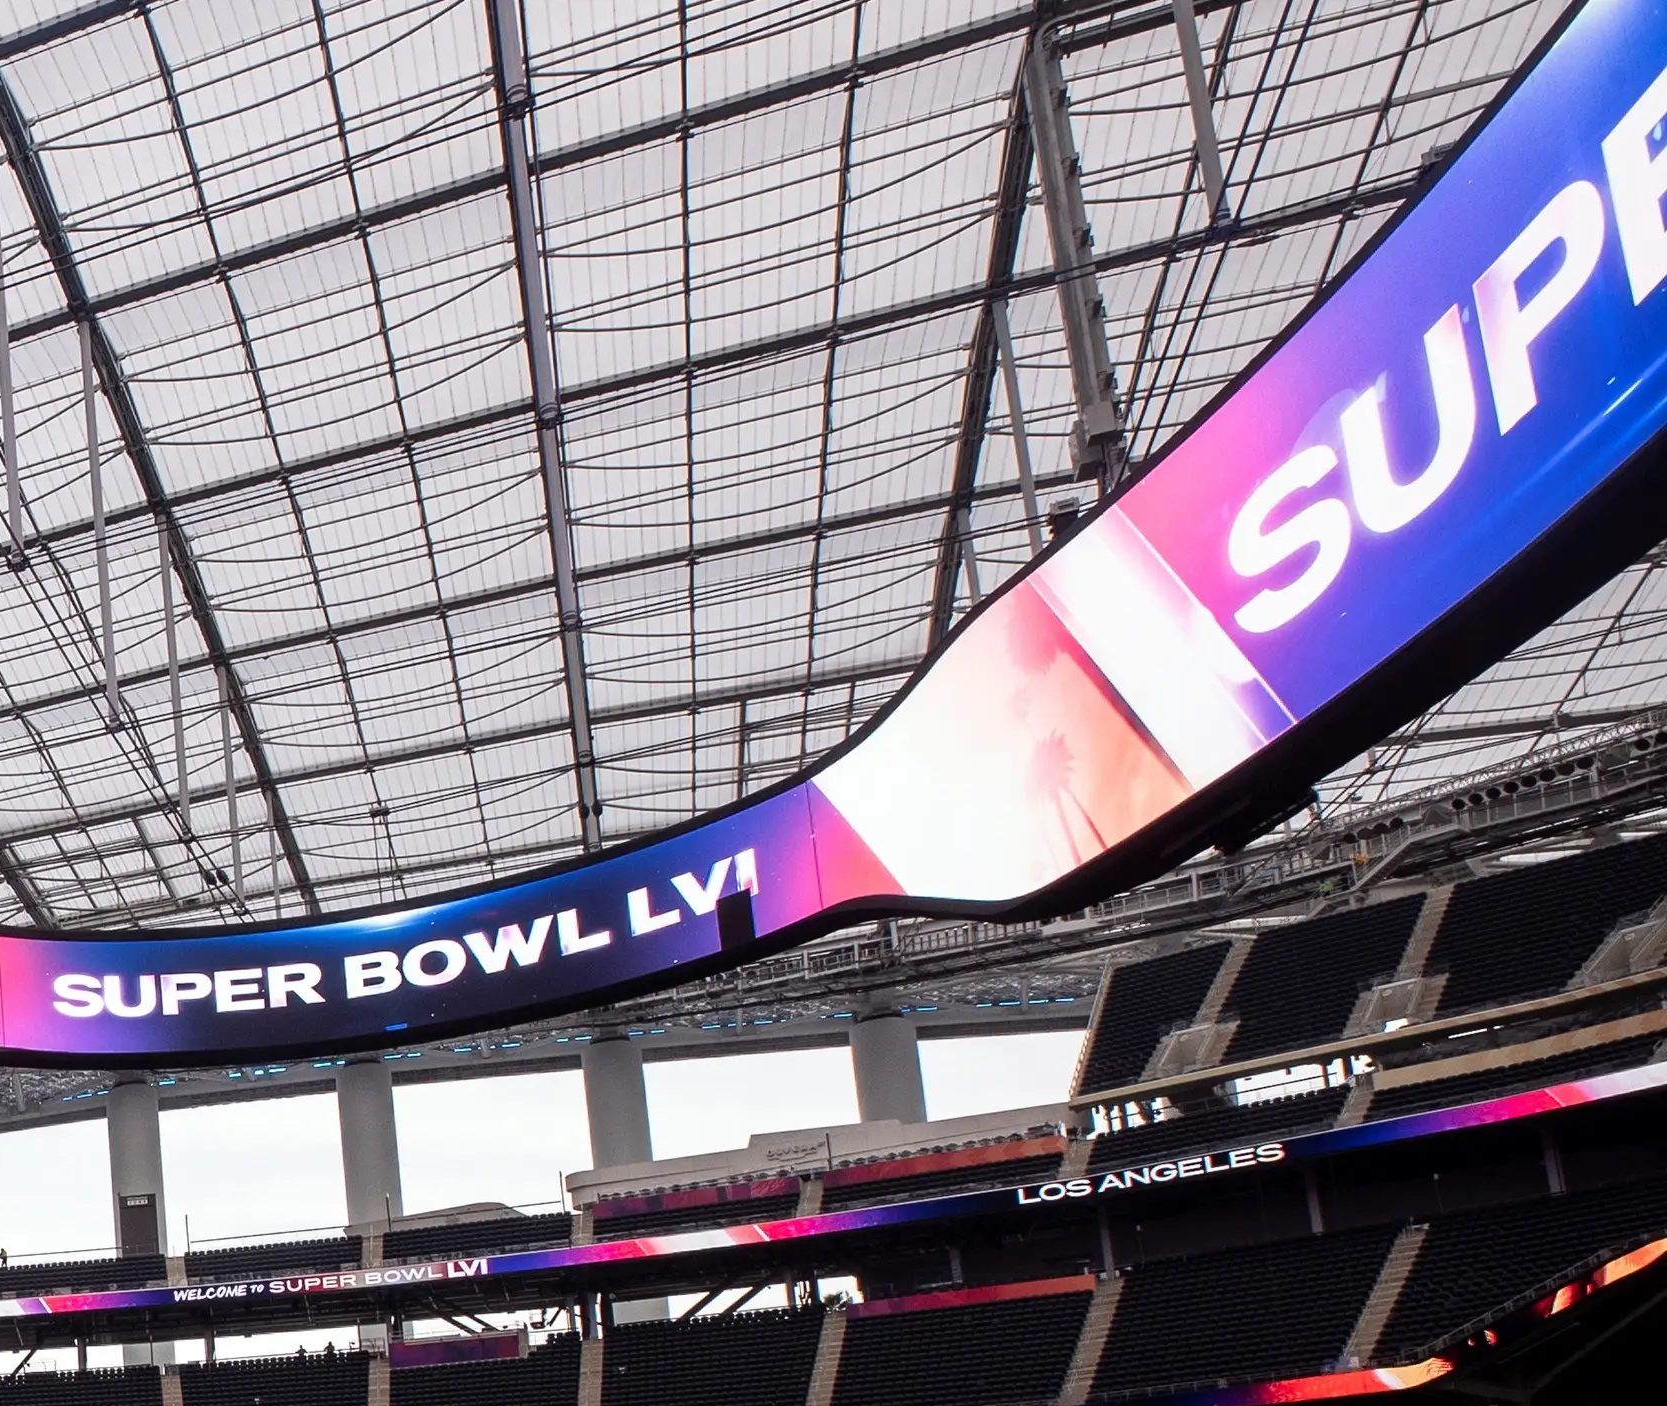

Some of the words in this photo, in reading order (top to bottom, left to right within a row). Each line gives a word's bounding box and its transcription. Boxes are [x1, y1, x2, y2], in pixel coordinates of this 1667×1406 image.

[52, 961, 327, 1019] SUPER
[344, 907, 612, 1000] BOWL
[628, 847, 761, 938] LVI
[1017, 1177, 1093, 1205] LOS
[1097, 1143, 1285, 1194] ANGELES
[173, 1283, 248, 1303] WELCOME
[269, 1274, 355, 1294] SUPER
[365, 1266, 442, 1285] BOWL
[447, 1258, 489, 1277] LVI
